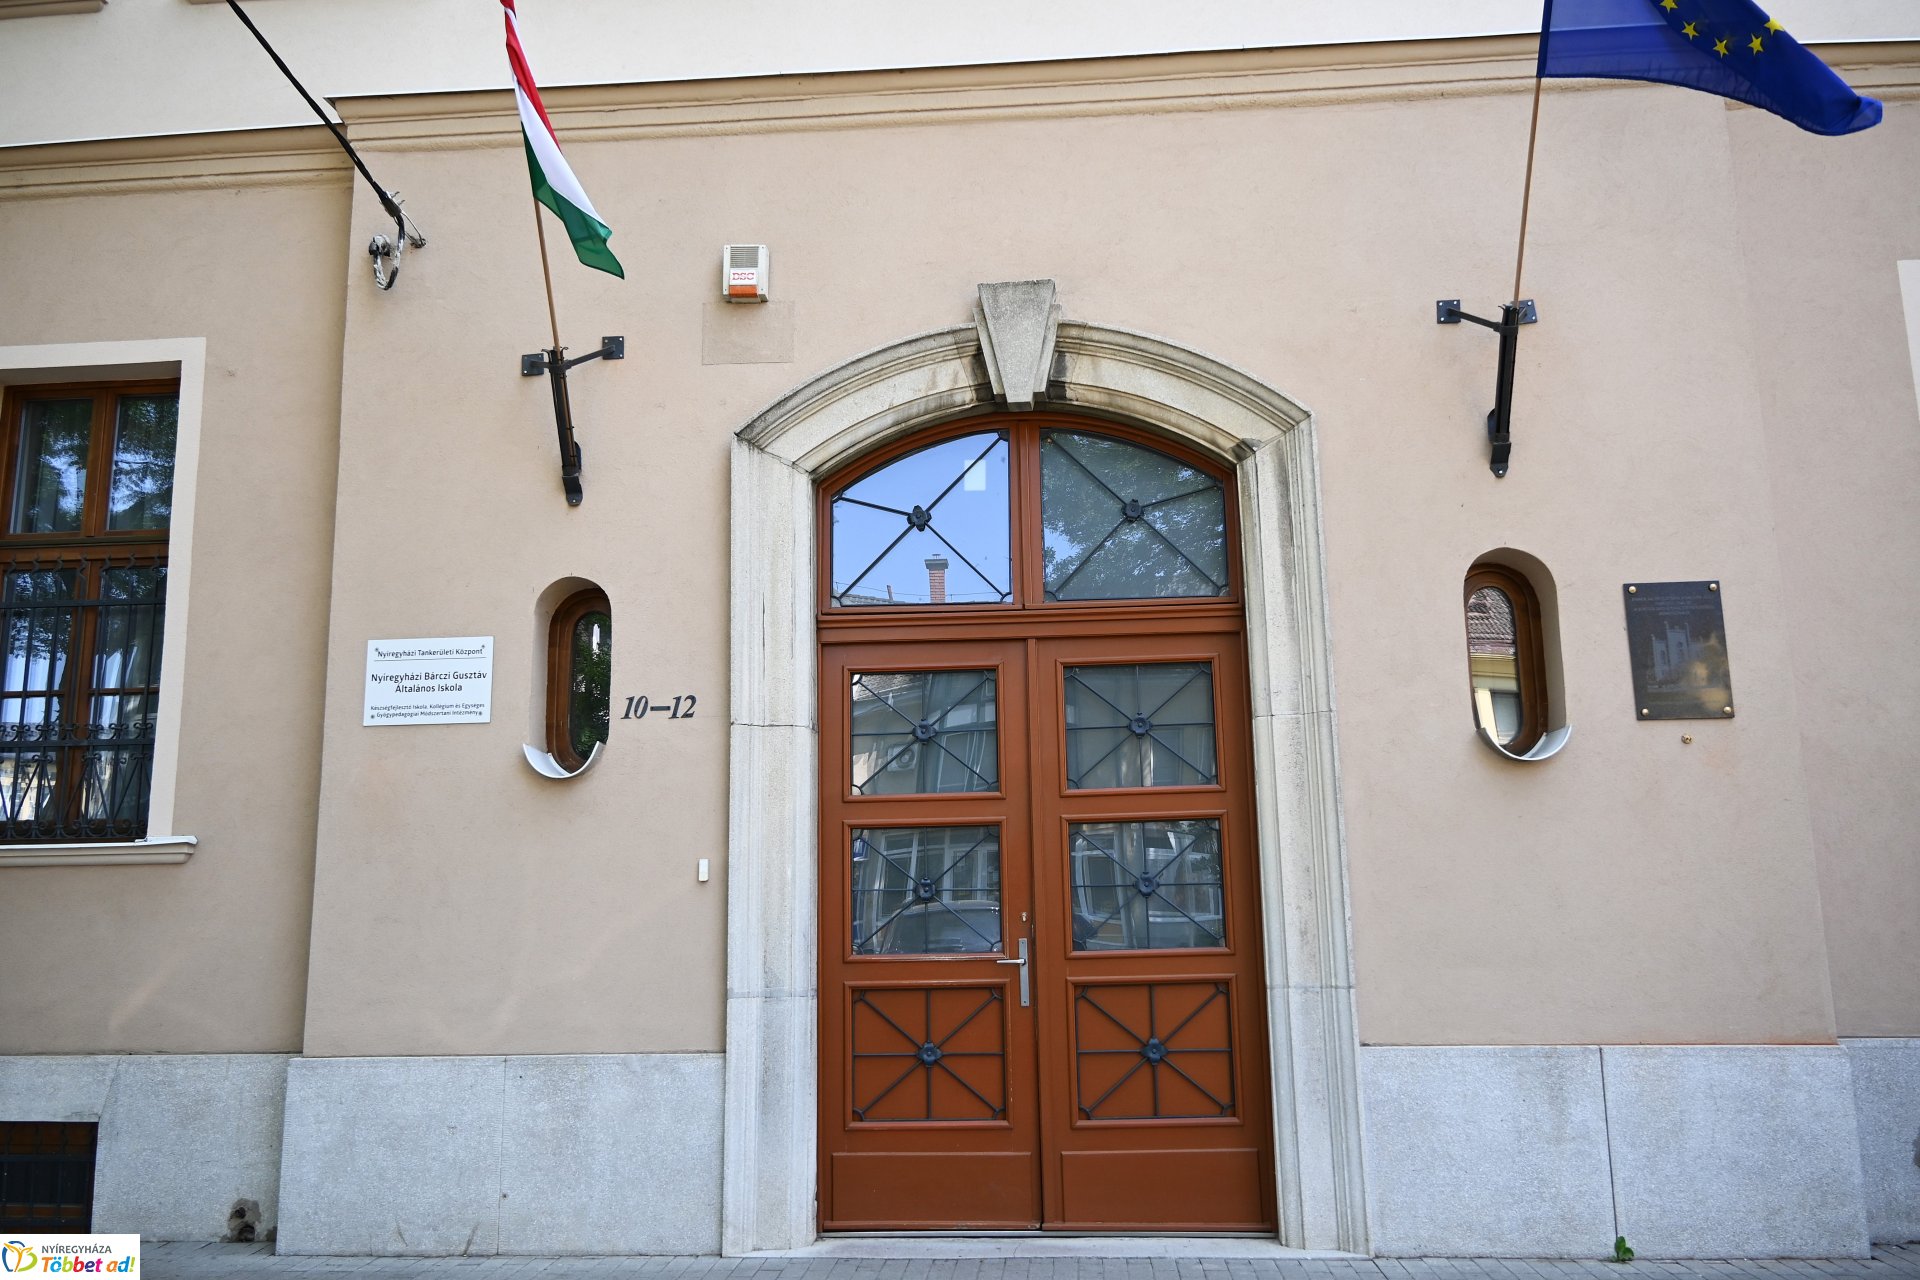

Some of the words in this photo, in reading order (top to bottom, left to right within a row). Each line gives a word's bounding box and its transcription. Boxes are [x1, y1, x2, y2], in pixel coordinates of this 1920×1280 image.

[732, 272, 755, 280] DSC
[377, 650, 417, 658] Nyíregyházi
[455, 648, 483, 656] Központ
[371, 672, 422, 684] Nyíregyházi
[424, 671, 451, 681] Bárczi
[453, 671, 487, 680] Gusztáv
[395, 684, 436, 693] Általános
[437, 683, 463, 692] Iskola
